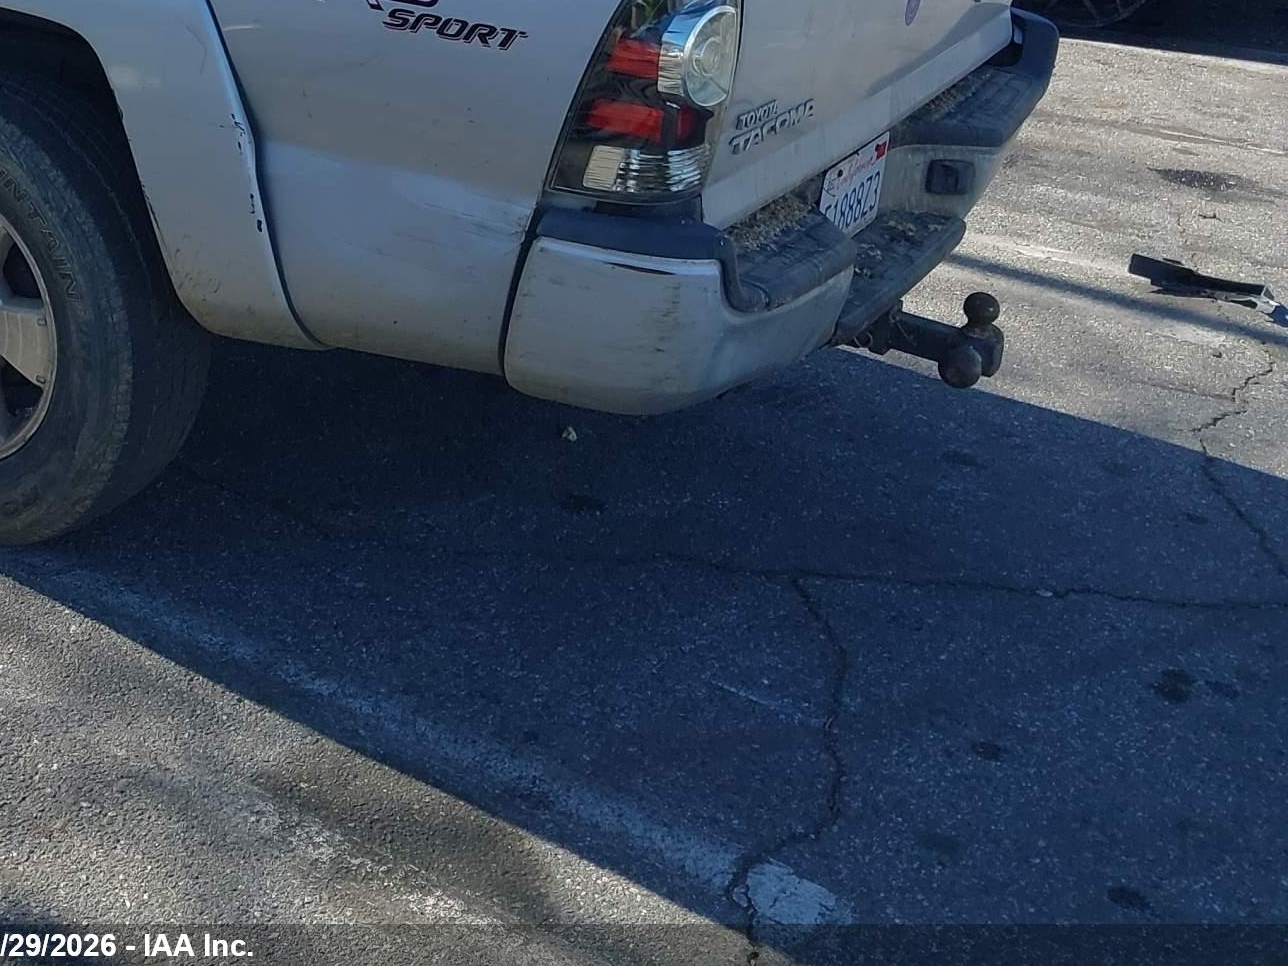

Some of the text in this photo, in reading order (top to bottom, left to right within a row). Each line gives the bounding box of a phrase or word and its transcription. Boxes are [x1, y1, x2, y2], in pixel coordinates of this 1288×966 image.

[382, 8, 529, 51] SPORT
[728, 97, 814, 155] TACOMA
[735, 98, 778, 131] TOYOTA
